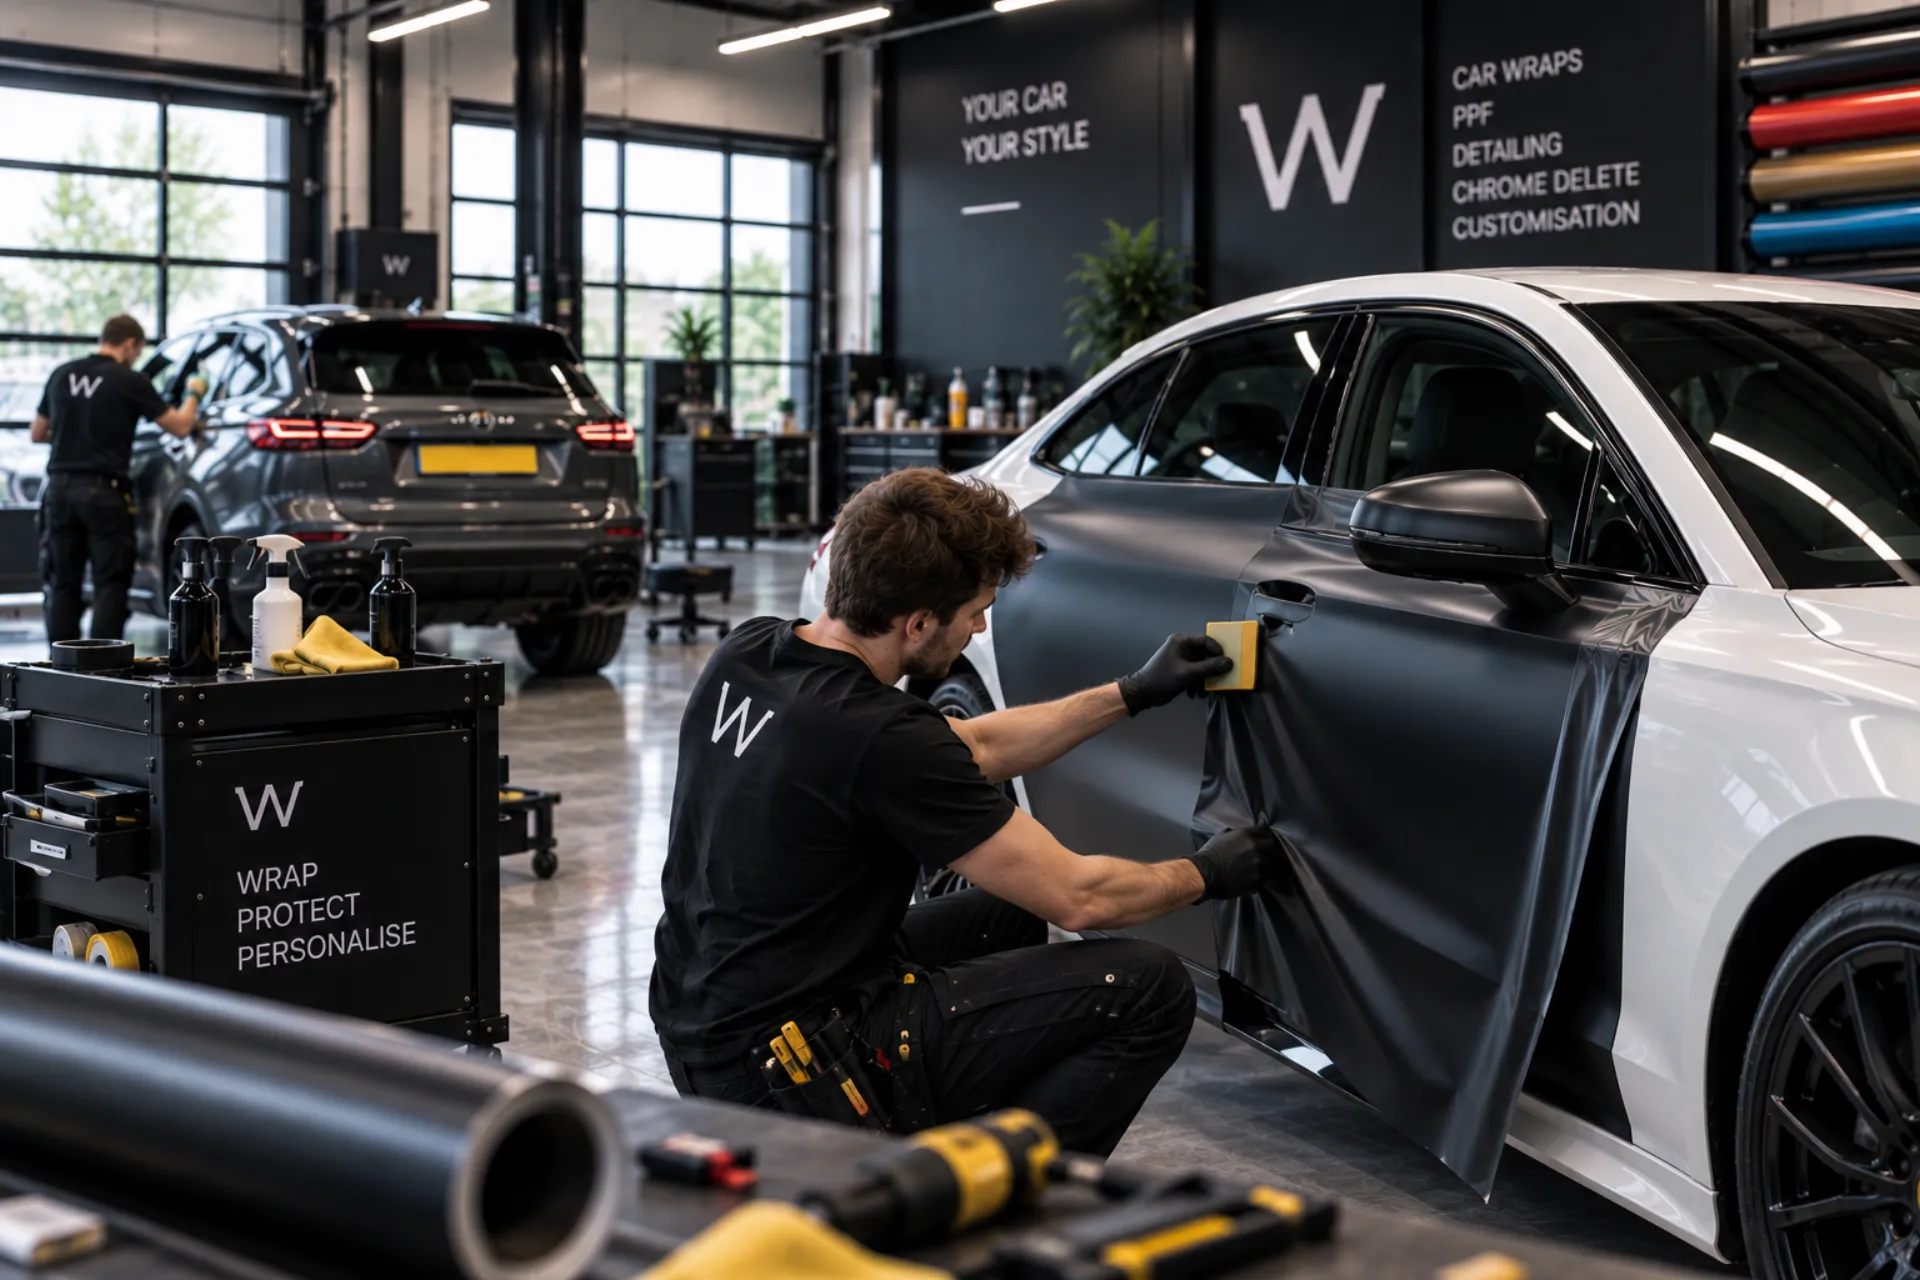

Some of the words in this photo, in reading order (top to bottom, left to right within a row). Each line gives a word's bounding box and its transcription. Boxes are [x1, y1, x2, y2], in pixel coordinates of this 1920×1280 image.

[1452, 62, 1497, 90] CAR
[1502, 48, 1583, 82] WRAPS
[962, 89, 1018, 122] YOUR
[1023, 81, 1067, 115] CAR
[1453, 101, 1493, 128] PPF
[962, 131, 1018, 163] YOUR
[1022, 120, 1089, 157] STYLE
[1239, 83, 1385, 211] W
[1452, 132, 1563, 168] DETAILING
[1452, 171, 1547, 204] CHROME
[1553, 162, 1640, 194] DELETE
[1452, 201, 1640, 240] CUSTOMISATION
[382, 256, 410, 275] W
[69, 373, 103, 398] W
[711, 680, 775, 758] W
[234, 780, 304, 831] W
[236, 862, 318, 895] WRAP
[237, 892, 361, 933] PROTECT
[237, 920, 416, 971] PERSONALISE
